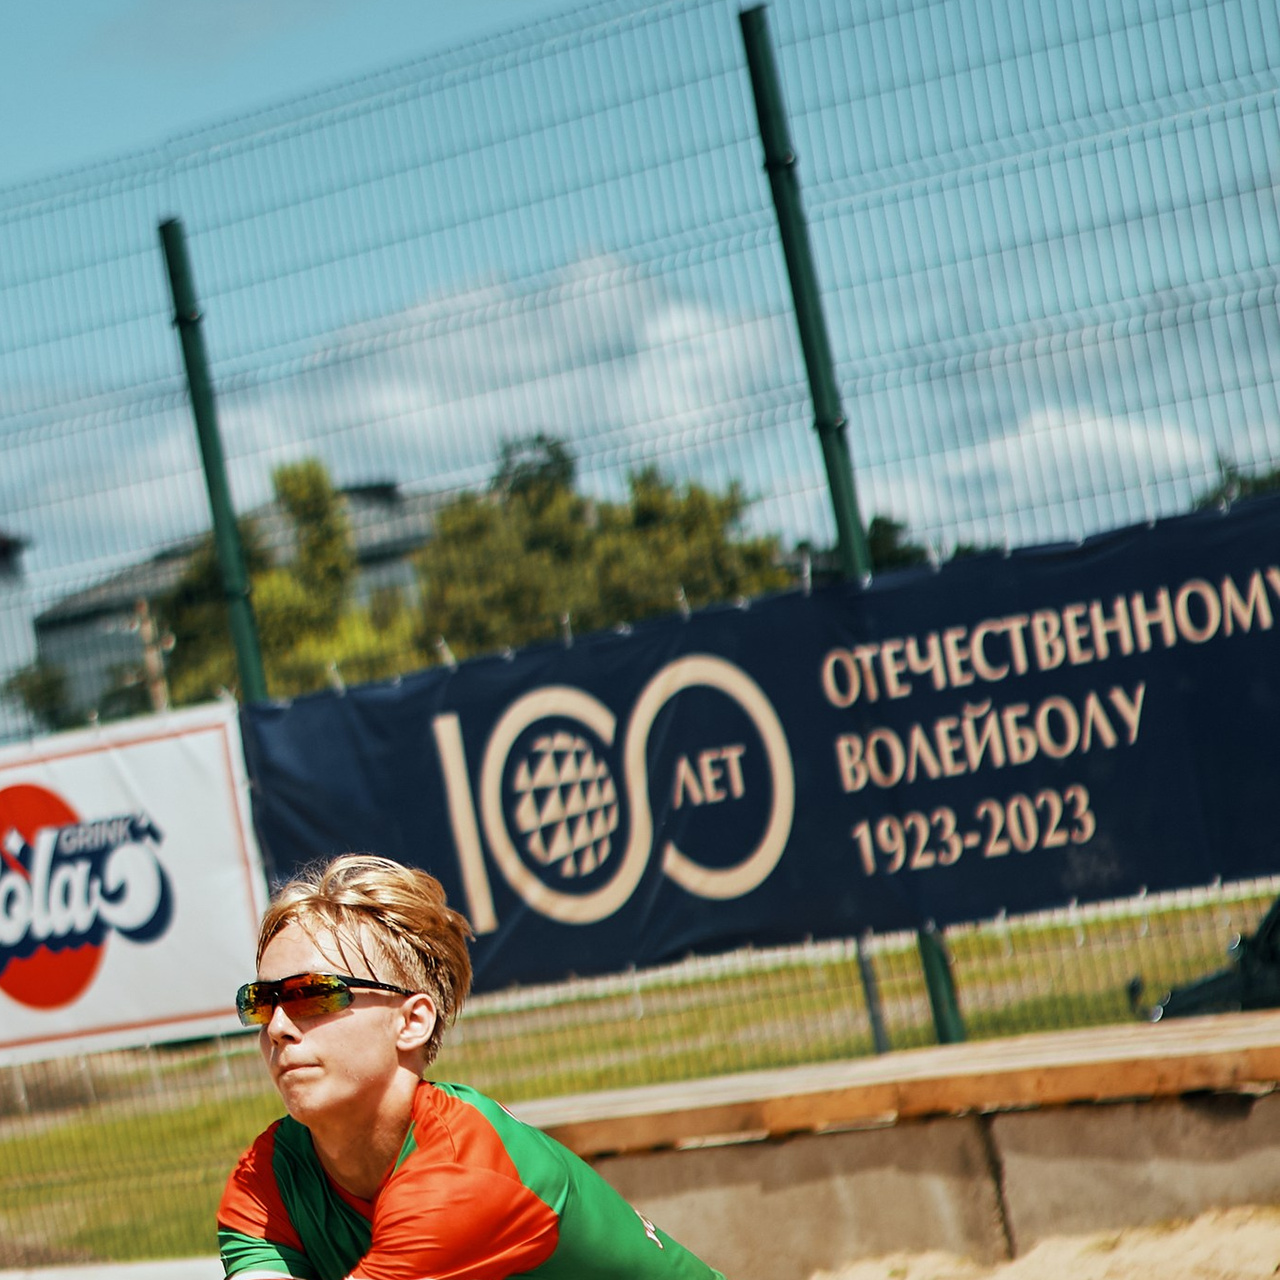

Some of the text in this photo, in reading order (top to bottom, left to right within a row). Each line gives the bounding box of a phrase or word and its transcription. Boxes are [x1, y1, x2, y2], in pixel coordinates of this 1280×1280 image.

[673, 744, 746, 810] ЛЕТ
[835, 681, 1146, 793] ВОЛЕЙБОЛУ
[851, 784, 1096, 876] 1923-2023
